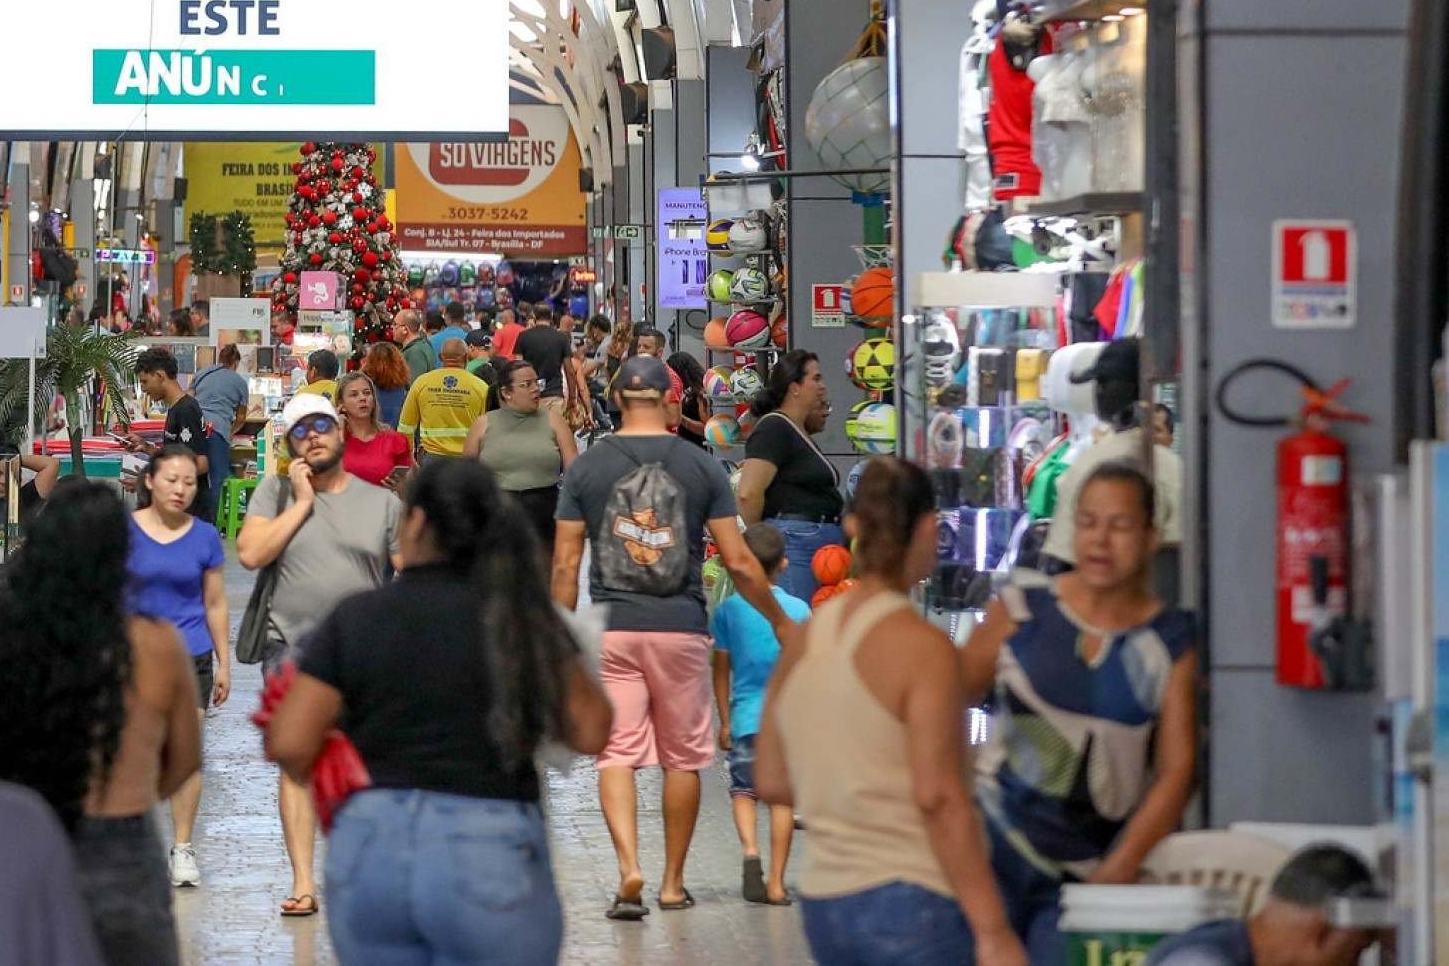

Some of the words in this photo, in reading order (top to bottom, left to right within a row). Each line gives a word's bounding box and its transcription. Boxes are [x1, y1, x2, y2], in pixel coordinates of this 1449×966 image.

[180, 0, 280, 36] ESTE
[470, 140, 556, 167] VIAGENS
[222, 162, 254, 176] FEIRA
[258, 163, 279, 175] DOS
[449, 207, 529, 221] 3037-5242
[404, 228, 426, 240] Conj.
[471, 228, 494, 237] Feira
[495, 228, 511, 238] dos
[513, 228, 565, 240] Importados
[531, 241, 544, 249] DF
